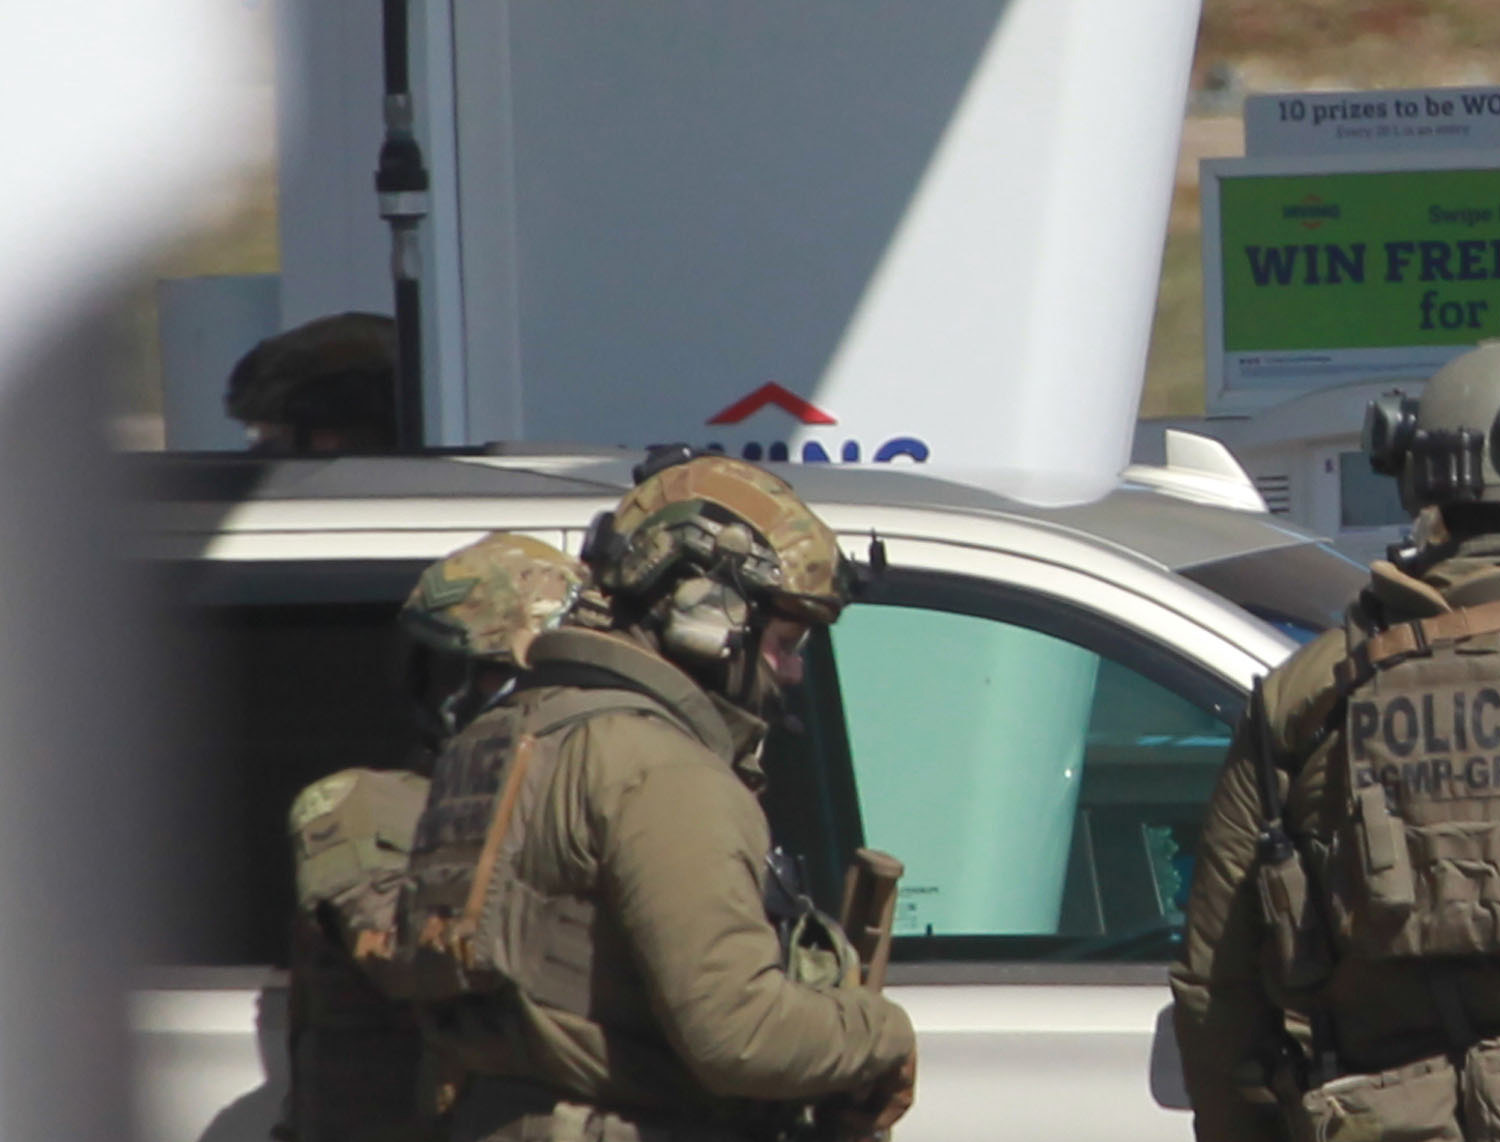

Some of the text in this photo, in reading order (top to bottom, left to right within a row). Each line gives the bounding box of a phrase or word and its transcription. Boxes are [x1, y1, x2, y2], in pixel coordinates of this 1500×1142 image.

[1279, 101, 1305, 122] 10
[1312, 99, 1387, 125] prizes
[1395, 99, 1419, 118] to
[1425, 96, 1454, 117] be
[1428, 203, 1492, 227] Swipe
[1244, 243, 1367, 286] WIN
[1419, 290, 1488, 330] for
